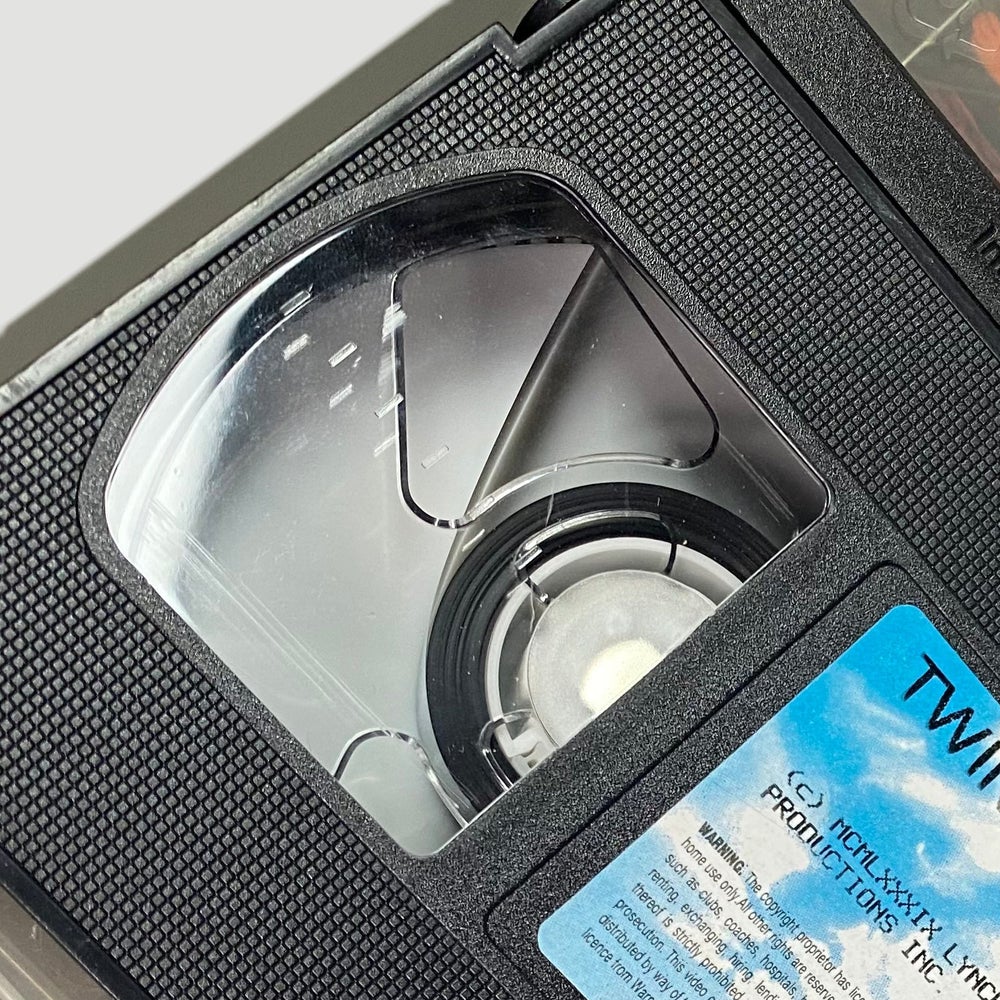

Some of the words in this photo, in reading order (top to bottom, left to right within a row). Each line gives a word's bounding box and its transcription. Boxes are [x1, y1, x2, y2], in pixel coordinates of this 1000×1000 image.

[664, 853, 688, 878] such
[680, 836, 707, 865] home
[747, 910, 772, 935] other
[765, 932, 794, 960] rights
[759, 782, 898, 934] PRODUCTIONS
[900, 938, 943, 993] INC.
[828, 816, 943, 941] MCMLXXXIX
[580, 926, 613, 962] licence
[610, 957, 633, 983] from
[598, 914, 647, 961] distributed
[652, 969, 673, 993] way
[631, 882, 666, 917] thereof
[671, 926, 702, 959] strictly
[744, 870, 762, 893] The
[759, 891, 800, 934] copyright
[792, 930, 837, 973] proprietor
[832, 969, 851, 991] has
[665, 949, 685, 972] This
[683, 970, 708, 997] video
